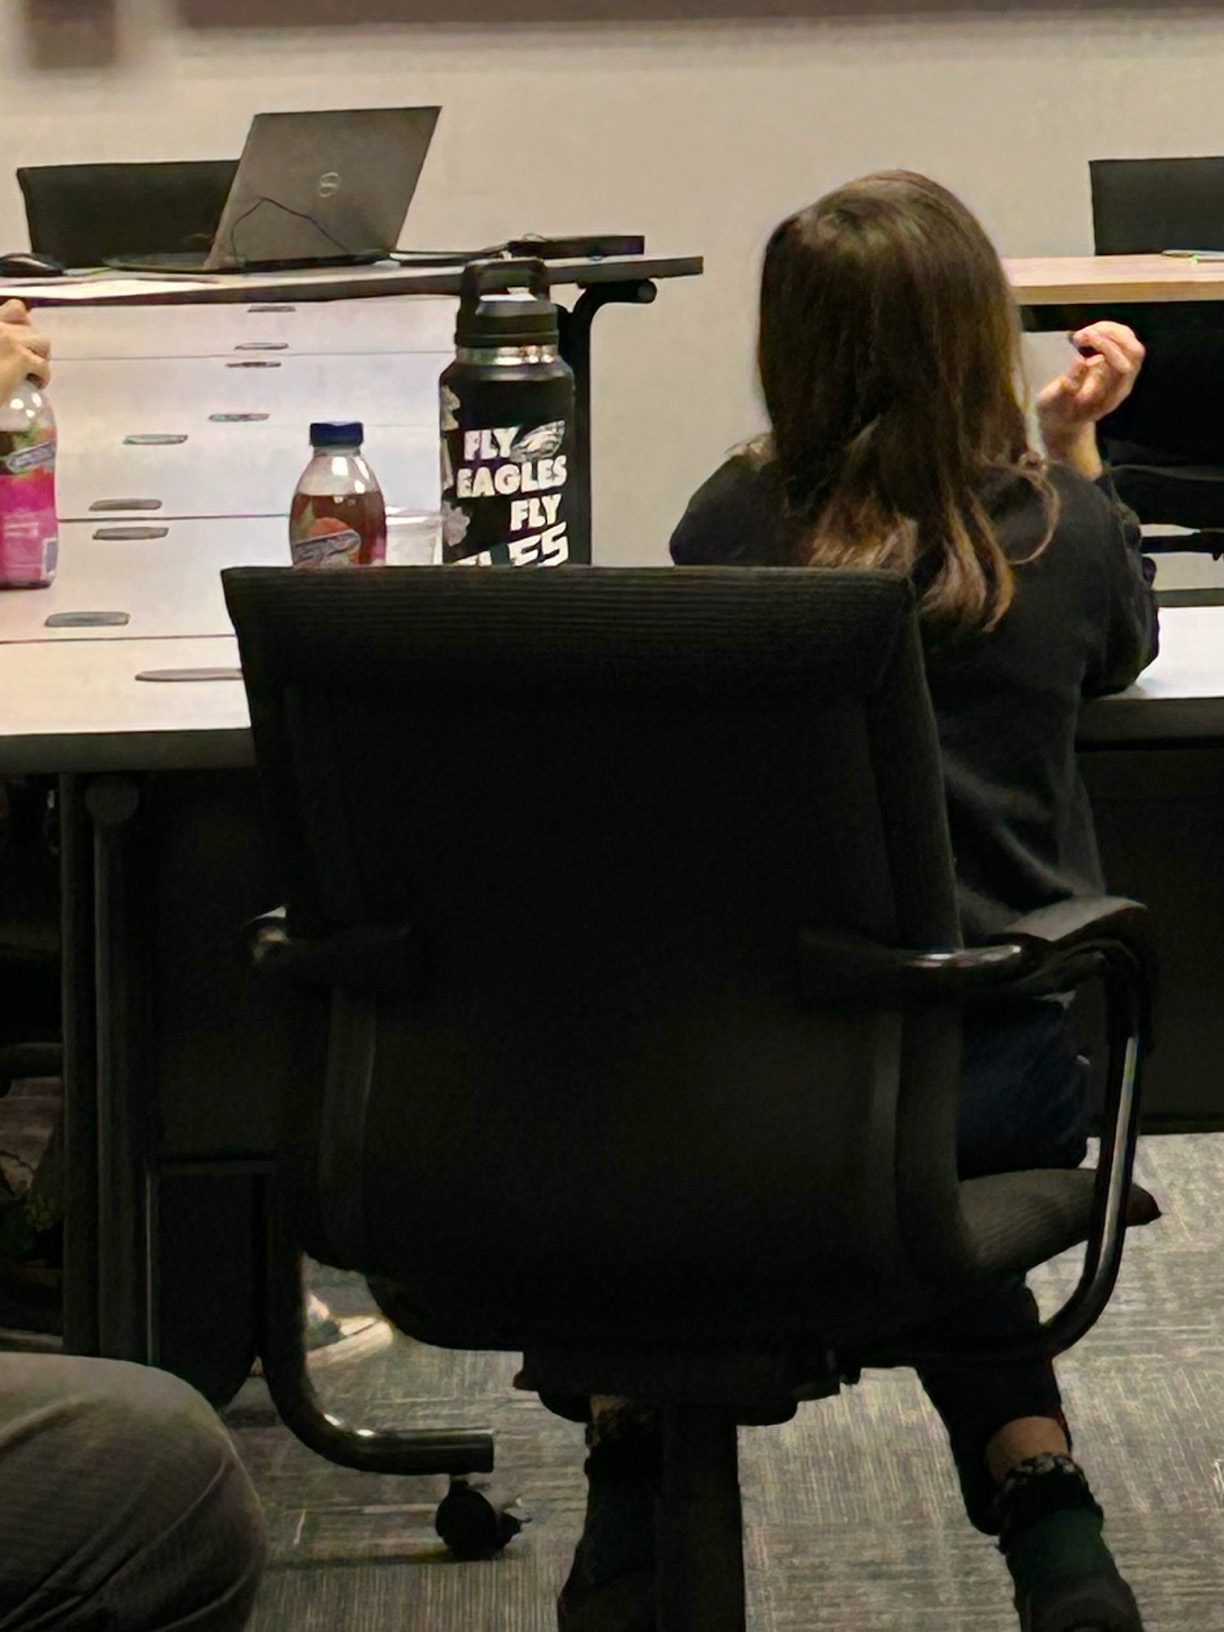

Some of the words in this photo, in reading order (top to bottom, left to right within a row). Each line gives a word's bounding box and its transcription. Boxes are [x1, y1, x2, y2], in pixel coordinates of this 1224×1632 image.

[464, 425, 521, 461] FLY
[456, 455, 568, 499] EAGLES
[510, 493, 562, 531] FLY
